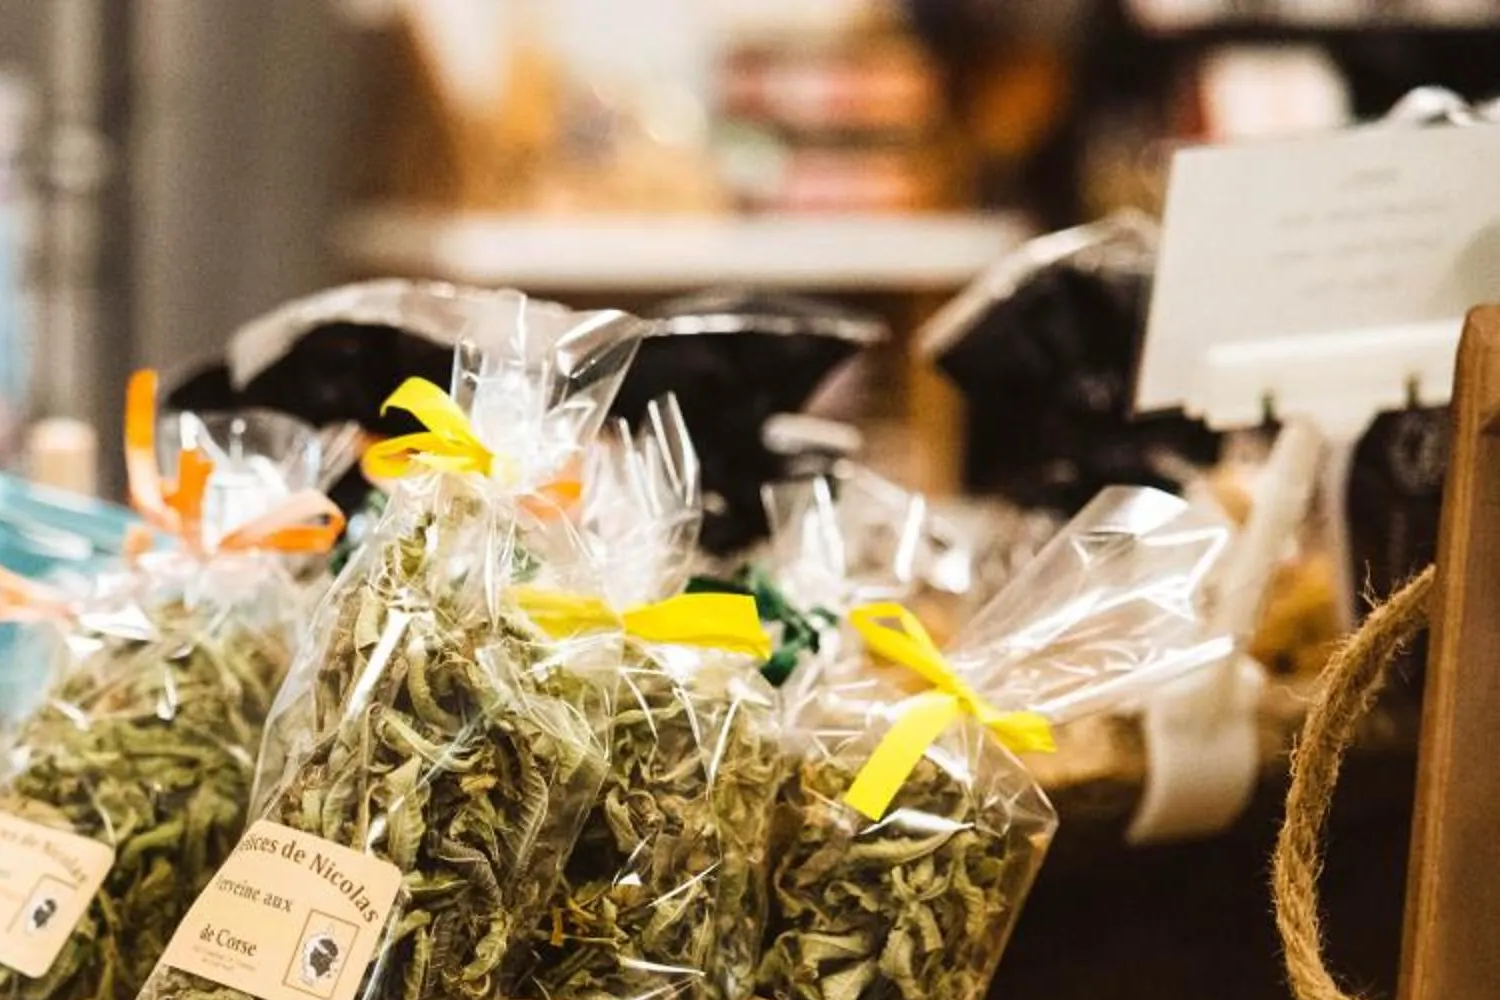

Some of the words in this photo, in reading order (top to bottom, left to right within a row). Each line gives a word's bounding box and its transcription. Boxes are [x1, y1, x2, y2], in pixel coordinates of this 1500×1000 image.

[281, 838, 307, 865] de
[309, 851, 379, 924] Nicolas
[263, 892, 293, 914] aux
[216, 928, 258, 957] Corse
